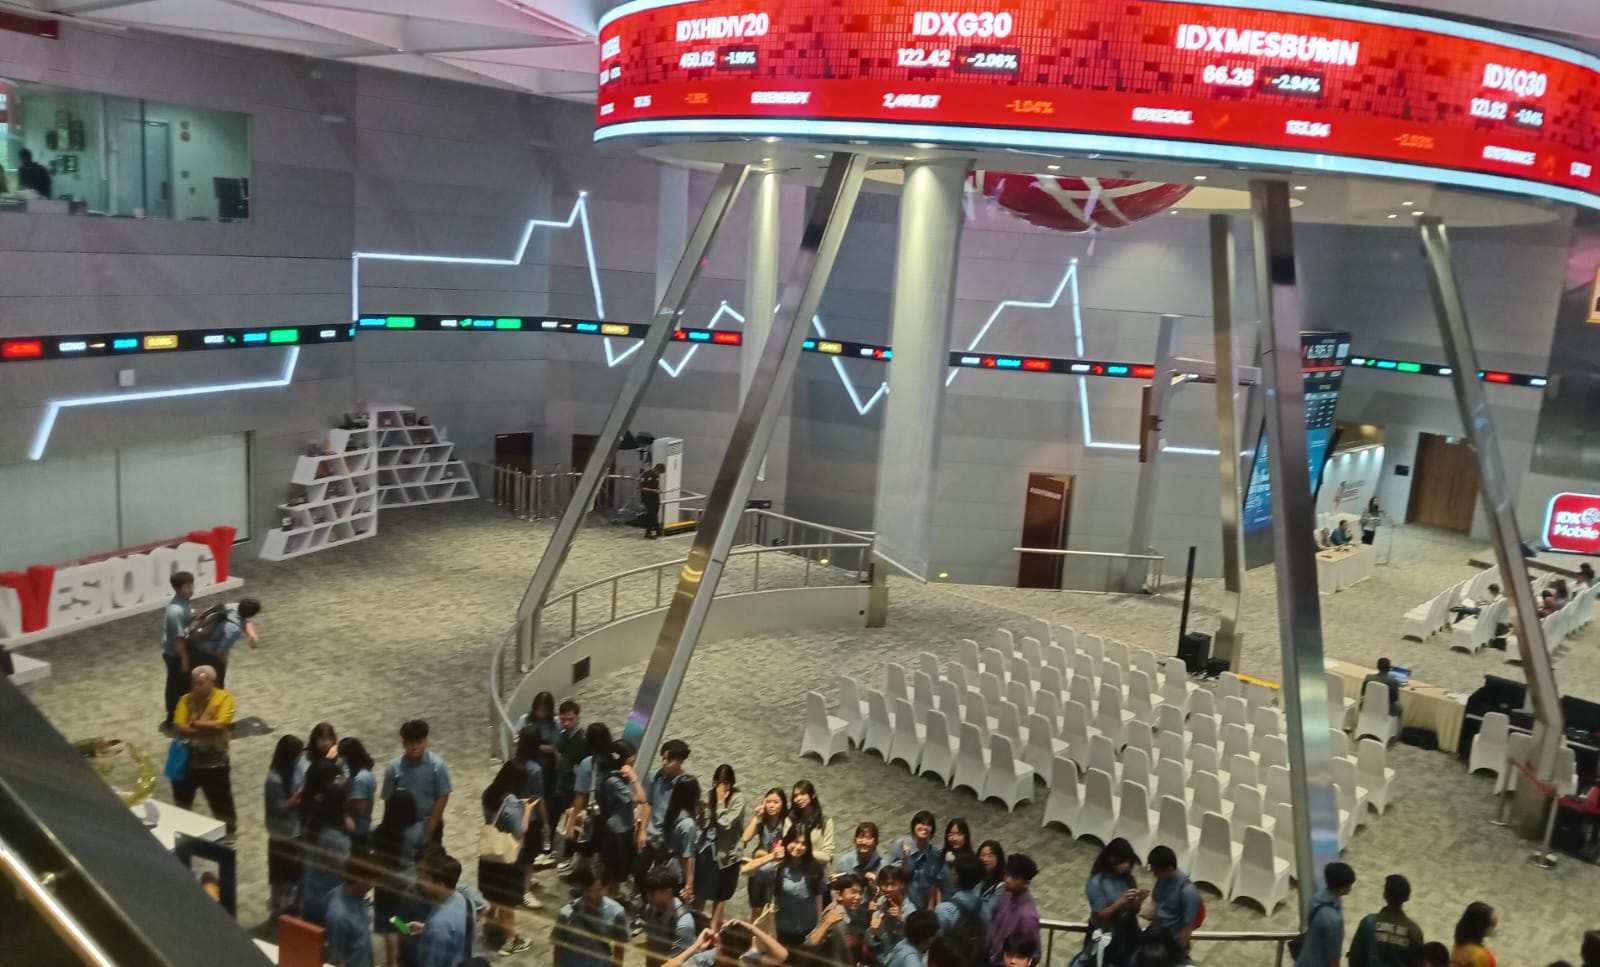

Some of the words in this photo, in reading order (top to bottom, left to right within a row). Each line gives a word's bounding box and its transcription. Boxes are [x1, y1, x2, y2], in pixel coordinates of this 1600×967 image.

[676, 13, 769, 41] IDXHIDIV20
[912, 12, 1013, 38] IDXG30
[897, 48, 951, 66] 122.42
[1482, 63, 1547, 97] IDXQ30
[1556, 511, 1582, 524] IDX
[1553, 524, 1600, 540] Mobile
